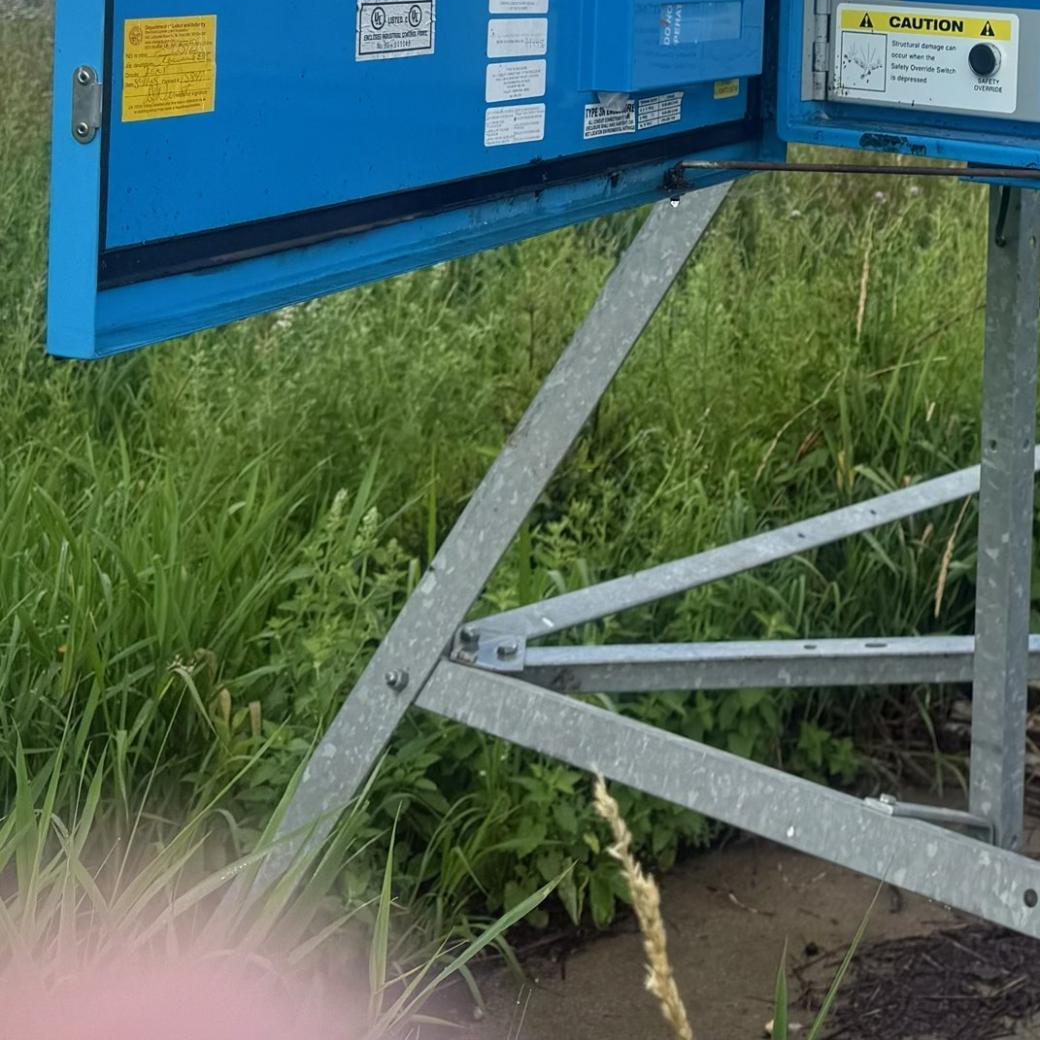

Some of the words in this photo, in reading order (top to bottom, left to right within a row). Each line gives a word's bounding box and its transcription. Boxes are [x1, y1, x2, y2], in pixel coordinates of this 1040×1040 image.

[889, 16, 964, 32] CAUTION
[892, 40, 920, 49] Structural
[922, 43, 944, 52] damage
[891, 63, 909, 73] Safety
[910, 65, 935, 73] Override
[974, 85, 1002, 93] OVERRIDE
